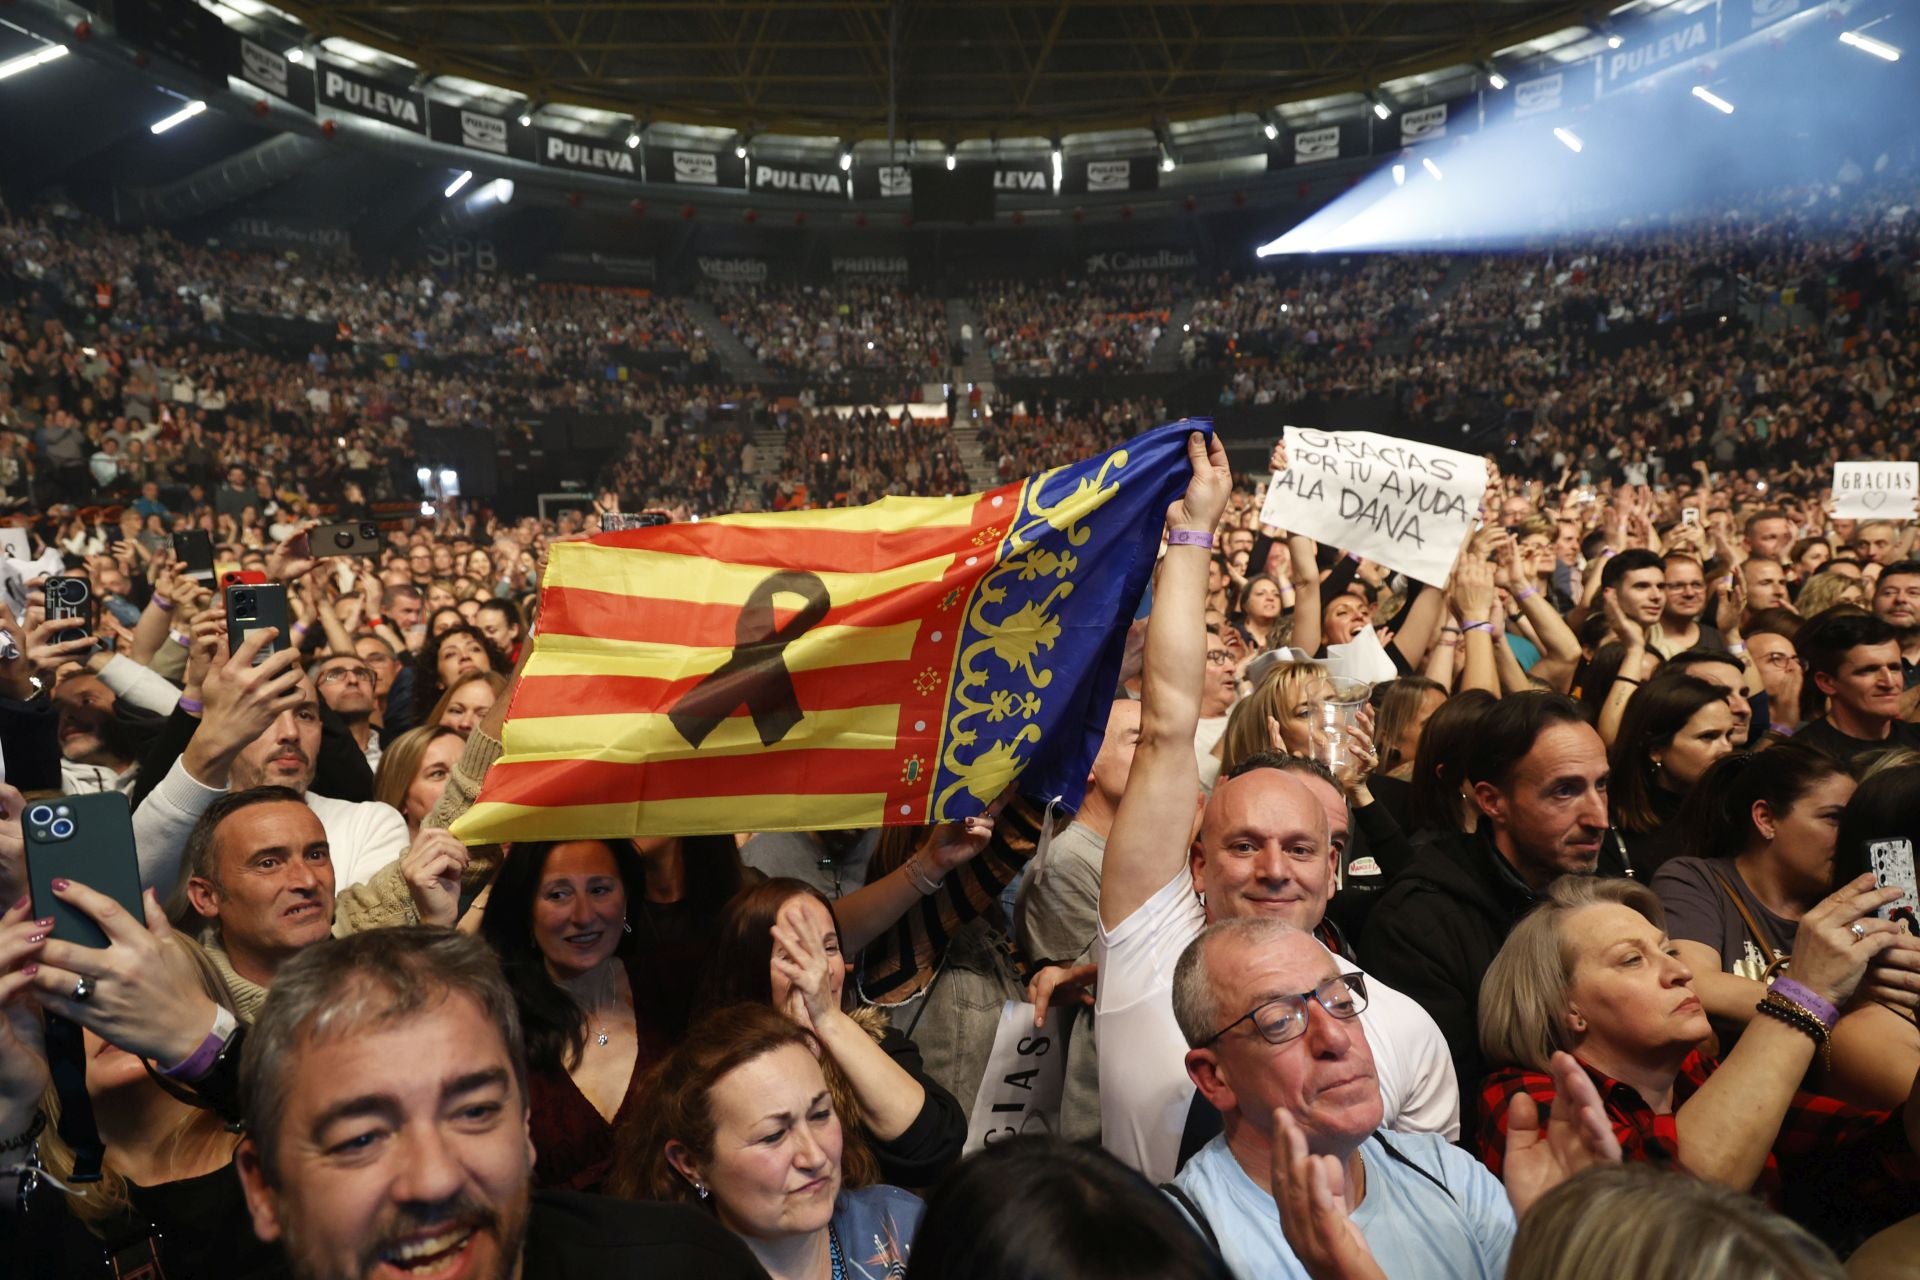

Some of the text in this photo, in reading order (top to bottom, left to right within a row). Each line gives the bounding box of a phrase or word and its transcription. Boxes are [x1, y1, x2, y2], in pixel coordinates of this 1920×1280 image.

[1610, 22, 1707, 80] PULEVA
[326, 70, 419, 124] PULEVA
[547, 137, 635, 174] PULEVA
[756, 165, 841, 193] PULEVA
[993, 171, 1047, 190] LEVA
[1110, 250, 1199, 271] CaixaBank
[1293, 448, 1339, 475] POR
[1344, 460, 1373, 484] TU
[1298, 430, 1458, 482] GRACIAS
[1841, 471, 1912, 490] GRACIAS
[1338, 488, 1426, 550] DANA
